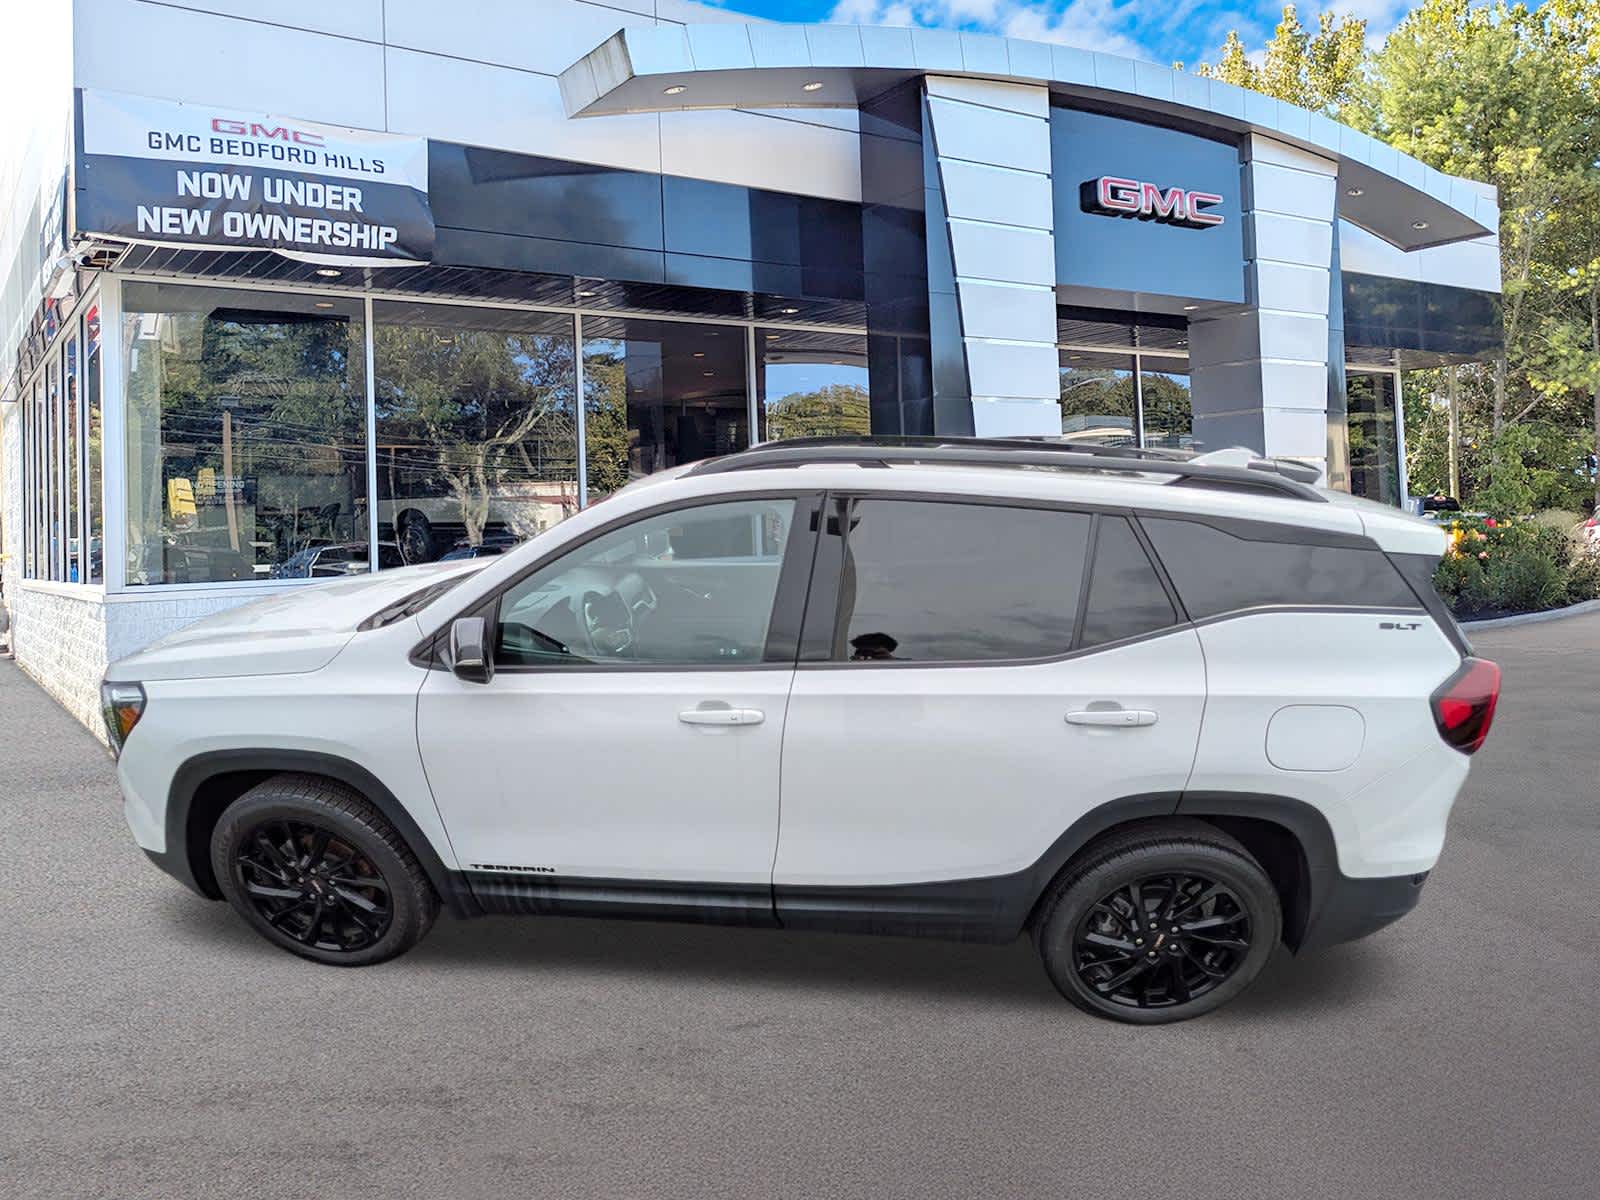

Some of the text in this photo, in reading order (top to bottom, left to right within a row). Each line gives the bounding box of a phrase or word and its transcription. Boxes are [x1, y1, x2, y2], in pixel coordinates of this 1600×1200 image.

[148, 131, 385, 174] GMC BEDFORD HILLS
[212, 118, 325, 148] GMC
[177, 170, 364, 213] NOW UNDER
[1098, 175, 1225, 225] GMC
[136, 205, 398, 250] NEW OWNERSHIP
